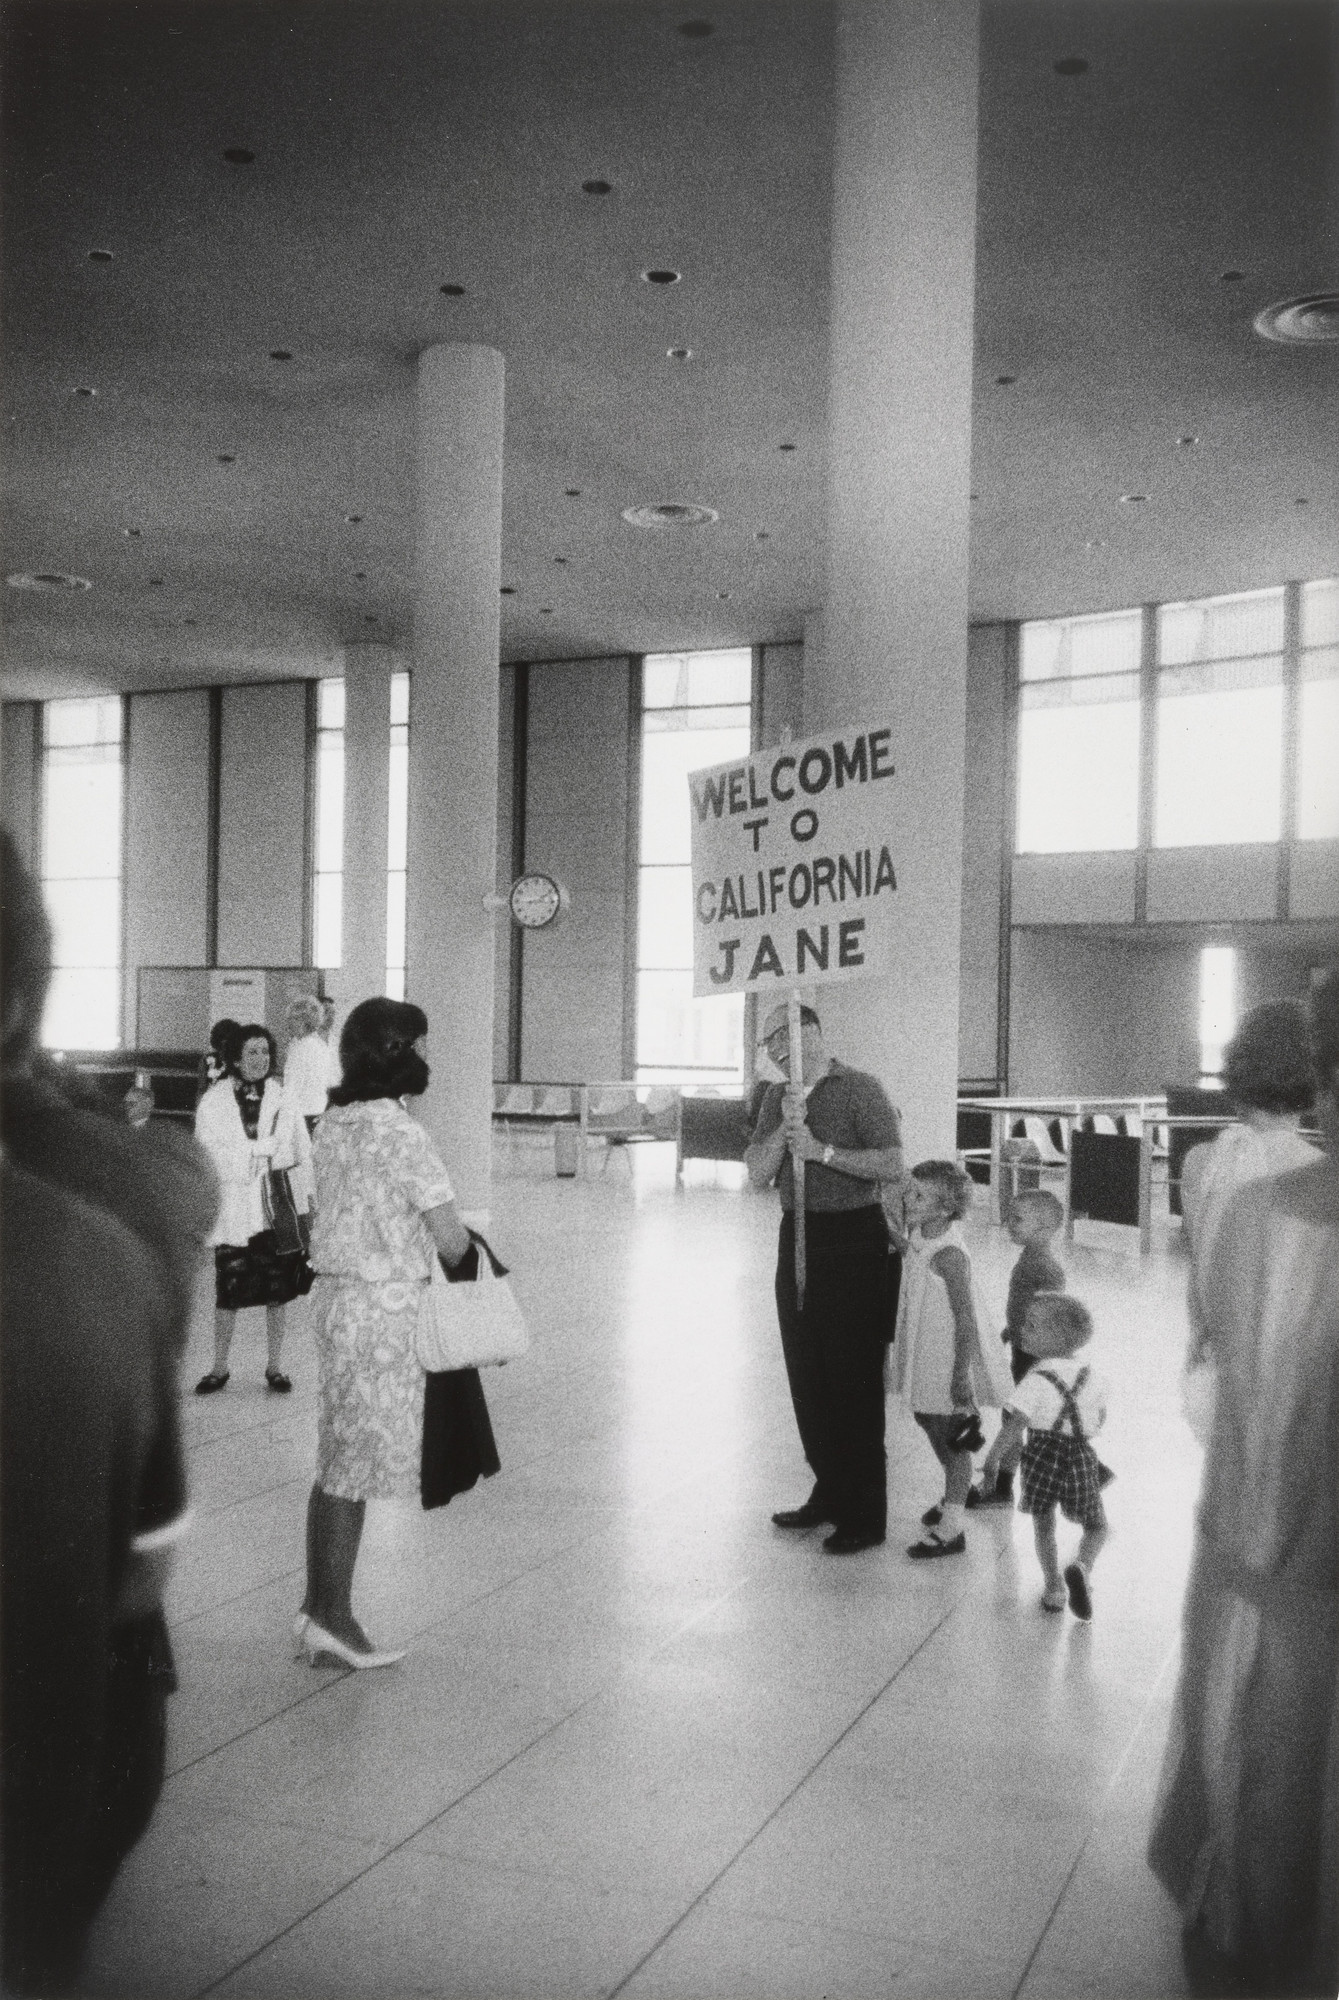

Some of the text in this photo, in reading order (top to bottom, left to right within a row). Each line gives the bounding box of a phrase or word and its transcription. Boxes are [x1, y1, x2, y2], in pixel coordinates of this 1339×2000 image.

[694, 728, 896, 822] WELCOME
[743, 808, 819, 852] TO
[697, 845, 897, 925] CALIFORNIA
[709, 918, 865, 984] JANE
